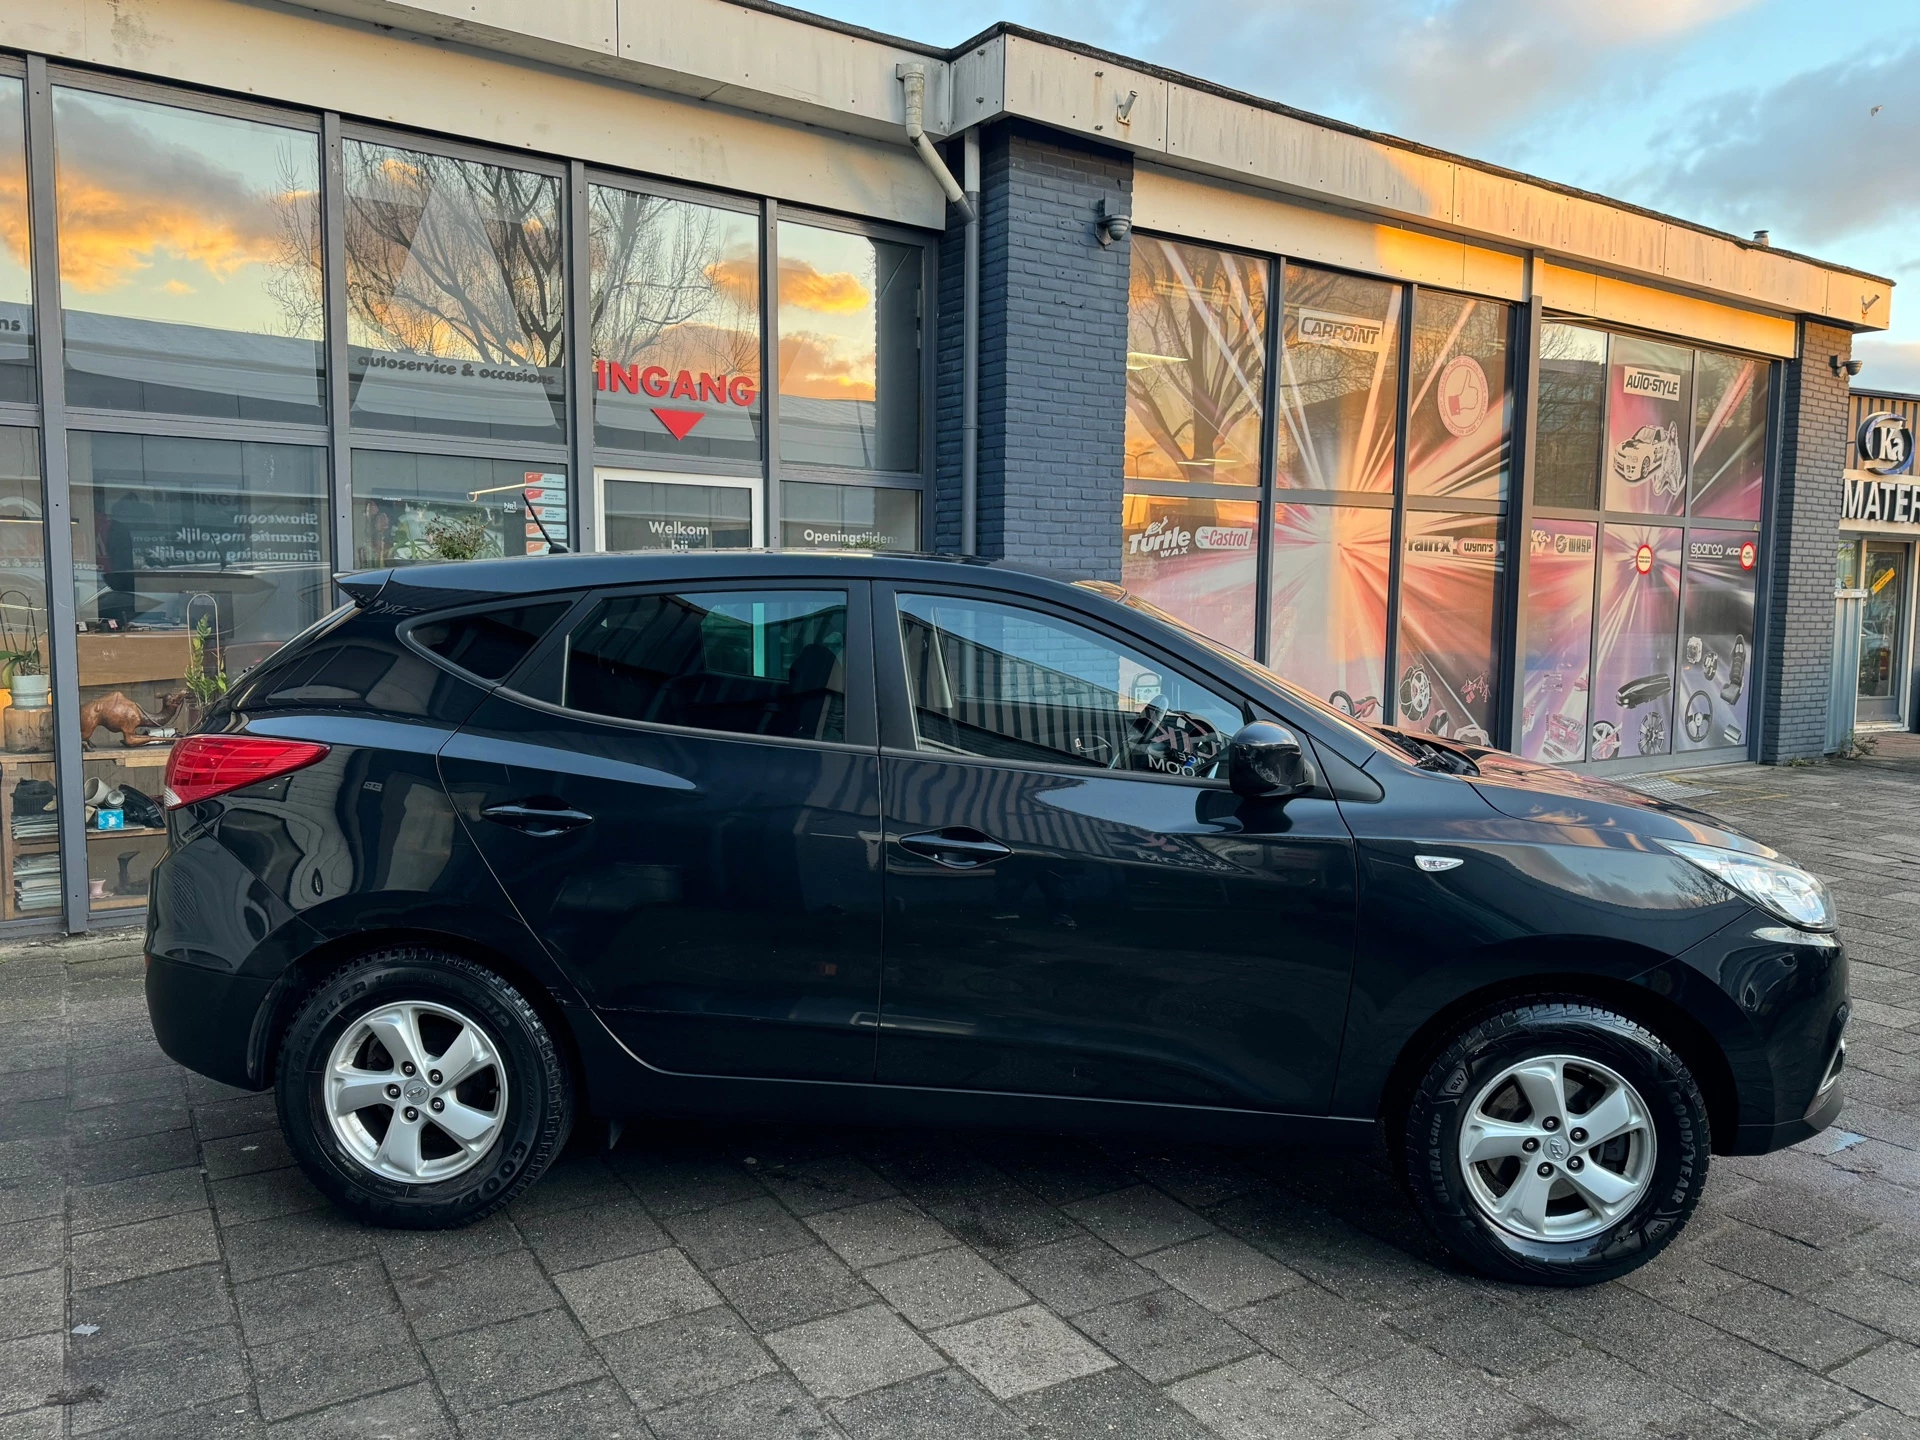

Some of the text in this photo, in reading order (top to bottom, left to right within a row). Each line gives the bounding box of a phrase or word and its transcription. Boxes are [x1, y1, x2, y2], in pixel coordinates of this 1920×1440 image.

[358, 354, 556, 385] autoservice & occasions
[596, 359, 757, 407] INGANG
[1626, 371, 1679, 396] AUTO-STYLE
[648, 520, 709, 536] Welkom
[1209, 529, 1249, 547] Castrol
[1128, 527, 1191, 555] Turtle
[1160, 546, 1189, 558] WAX
[1451, 1073, 1465, 1091] SUV
[1429, 1112, 1443, 1146] GRIP
